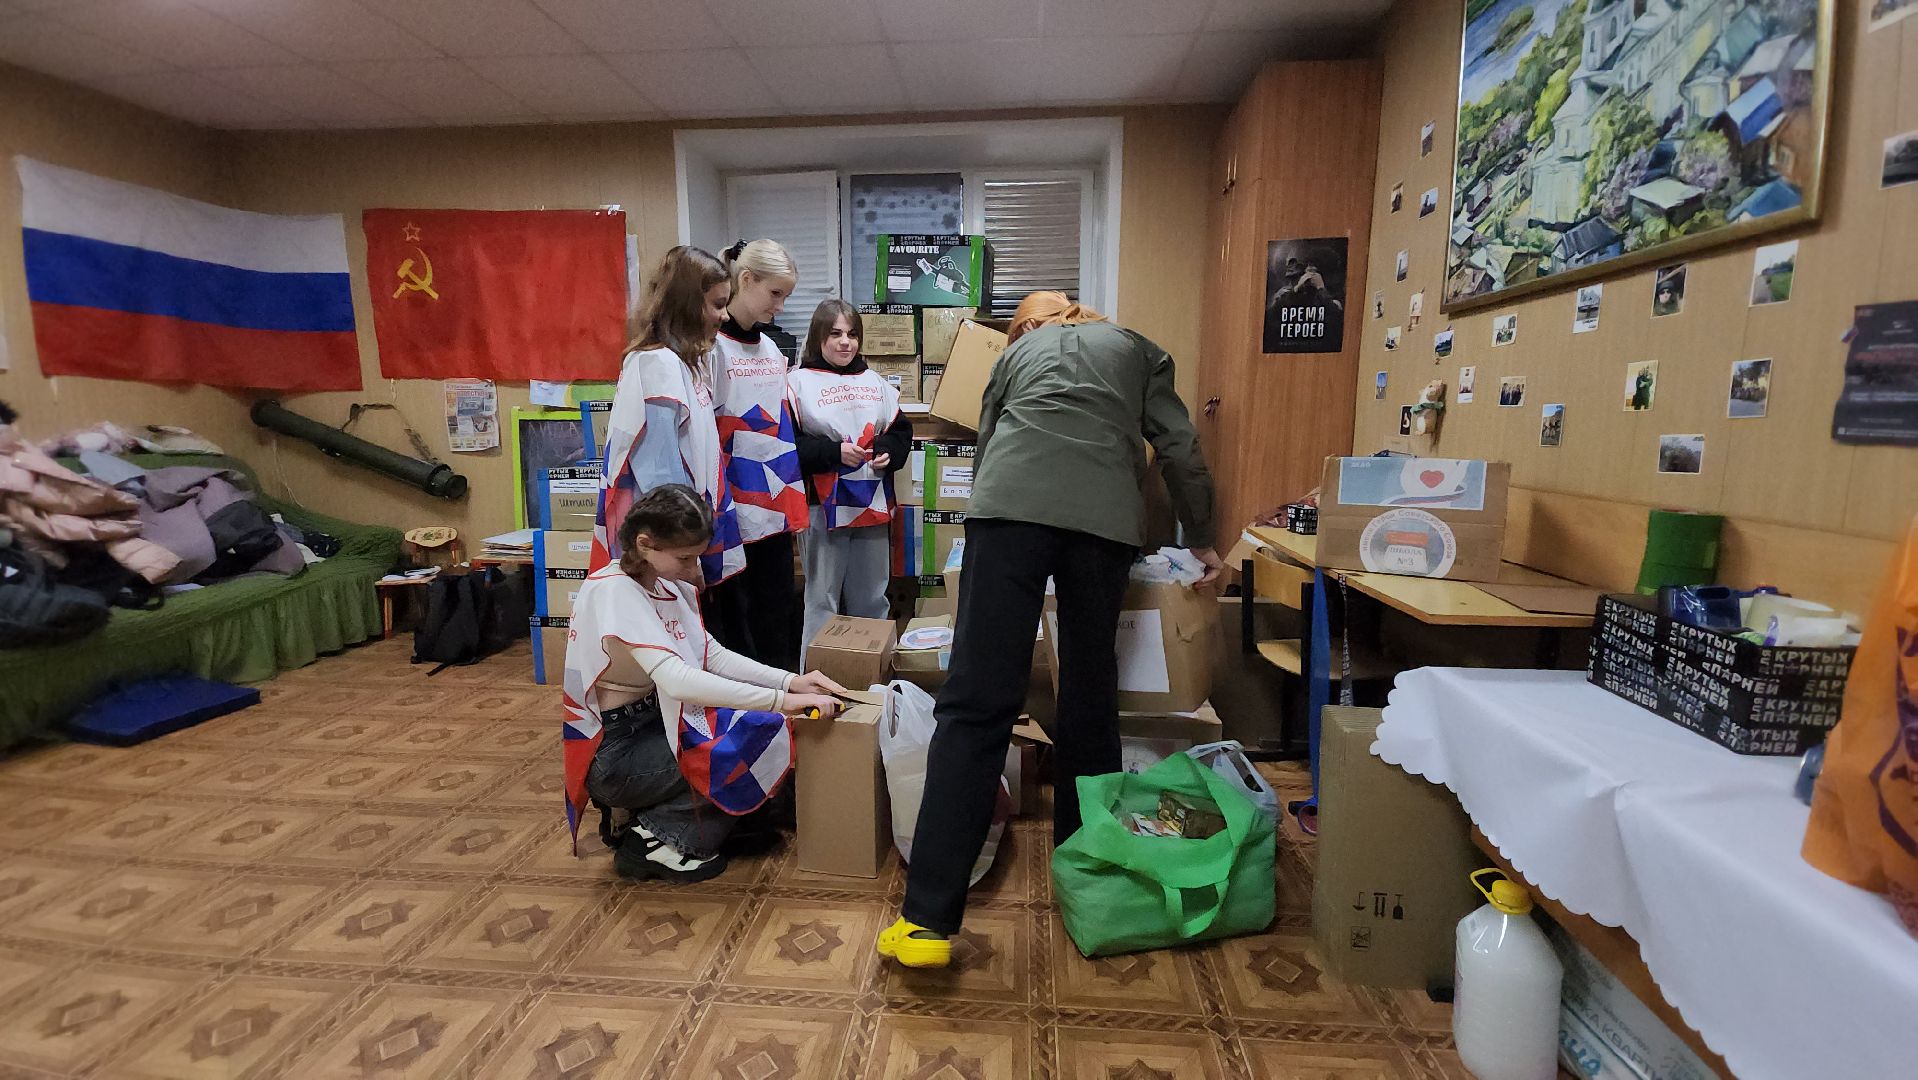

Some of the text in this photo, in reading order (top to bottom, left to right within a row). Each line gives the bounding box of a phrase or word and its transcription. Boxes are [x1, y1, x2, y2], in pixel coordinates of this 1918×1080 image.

[889, 246, 940, 254] FAVOURITE
[1281, 306, 1325, 322] ВРЕМЯ
[1280, 322, 1325, 338] ГЕРОЕВ
[1612, 602, 1658, 626] КРУТЫХ
[1610, 624, 1655, 657] КРУТЫХ
[1680, 624, 1738, 654] КРУТЫХ
[1610, 651, 1655, 677] КРУТЫХ
[1774, 650, 1849, 664] КРУТЫХ
[1675, 660, 1731, 699] КРУТЫХ
[1730, 722, 1800, 742] КРУТЫХ
